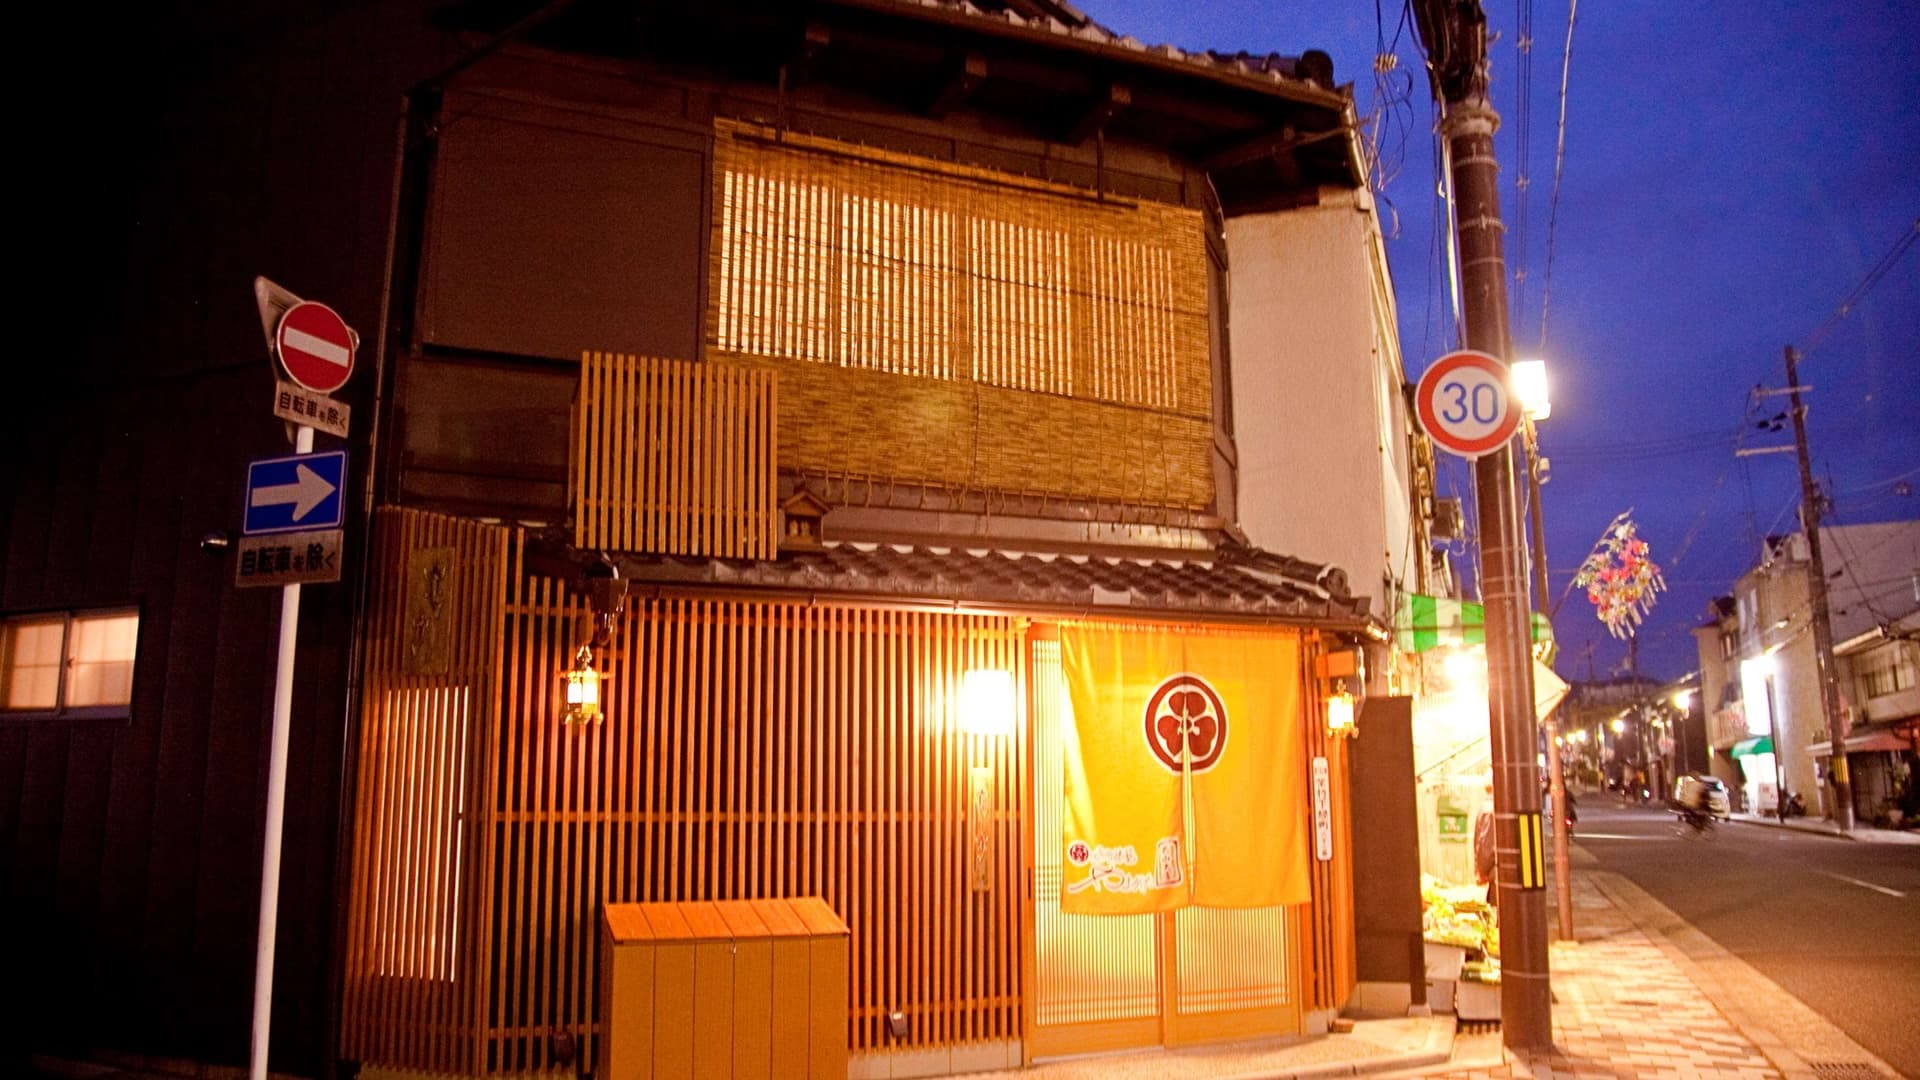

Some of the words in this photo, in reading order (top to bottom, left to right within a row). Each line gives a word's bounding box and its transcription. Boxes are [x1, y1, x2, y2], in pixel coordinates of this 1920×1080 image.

[279, 391, 346, 431] 自転車を除く
[1442, 382, 1499, 424] 30
[241, 542, 336, 577] 自転車を除く
